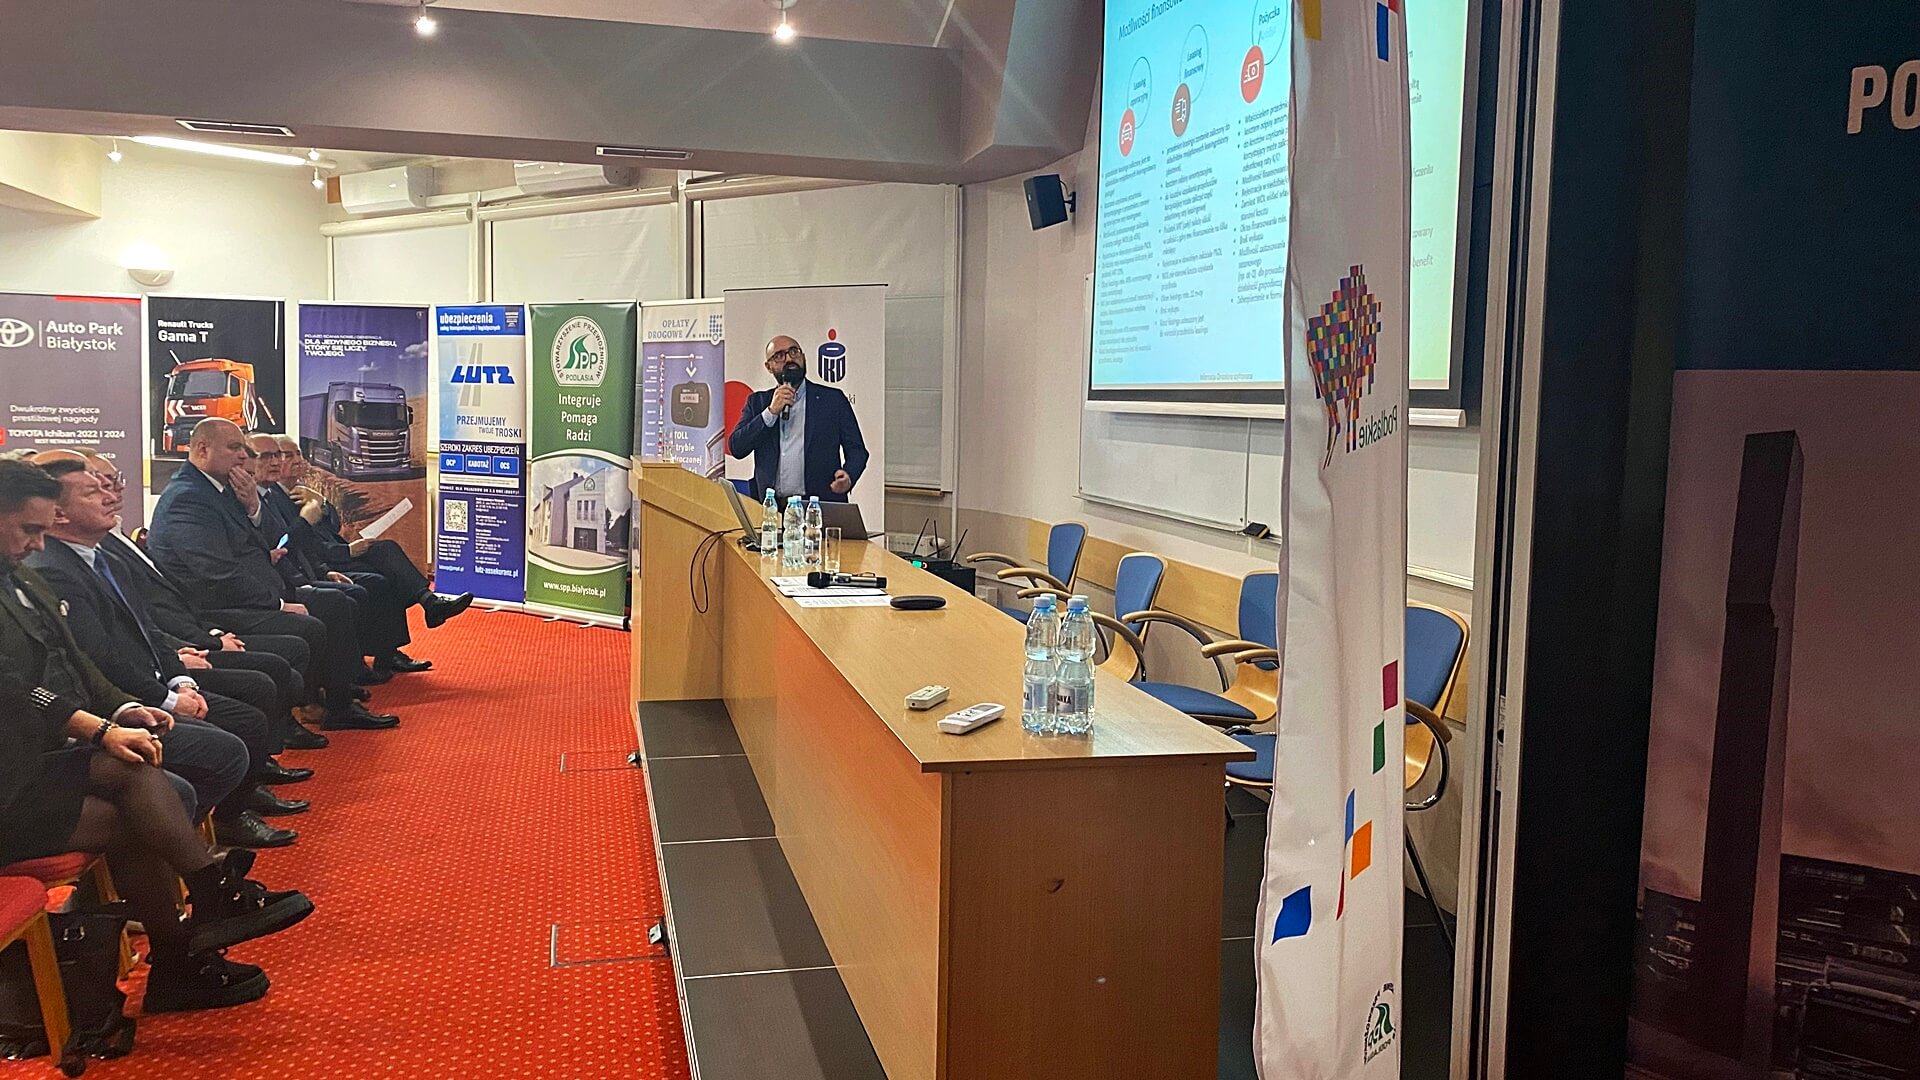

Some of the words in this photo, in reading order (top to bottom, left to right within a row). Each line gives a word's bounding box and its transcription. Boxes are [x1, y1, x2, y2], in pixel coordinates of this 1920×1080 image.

[157, 319, 187, 328] Renault
[188, 320, 214, 329] Trucks
[440, 311, 493, 326] ubezpieczenia
[662, 319, 690, 328] OPŁATY
[46, 320, 86, 334] Auto
[88, 321, 124, 336] Park
[158, 330, 197, 343] Gama
[198, 331, 209, 343] T
[647, 330, 683, 339] DROGOWE
[47, 335, 117, 353] Białystok
[450, 365, 515, 384] LUTZ
[558, 394, 602, 408] Integruje
[9, 405, 57, 415] Dwukrotny
[58, 406, 100, 415] zwycięzca
[12, 414, 61, 424] prestiżowej
[63, 415, 98, 424] nagrody
[456, 415, 507, 426] PRZEJMUJEMY
[561, 411, 598, 426] Pomaga
[8, 429, 44, 437] TOYOTA
[45, 429, 76, 437] Ichiban
[76, 430, 98, 438] 2022
[104, 430, 125, 439] 2024
[495, 428, 522, 438] TROSKI
[566, 429, 592, 442] Radzi
[440, 443, 461, 453] SZEROKI
[461, 443, 483, 454] ZAKRES
[675, 443, 695, 453] trybie
